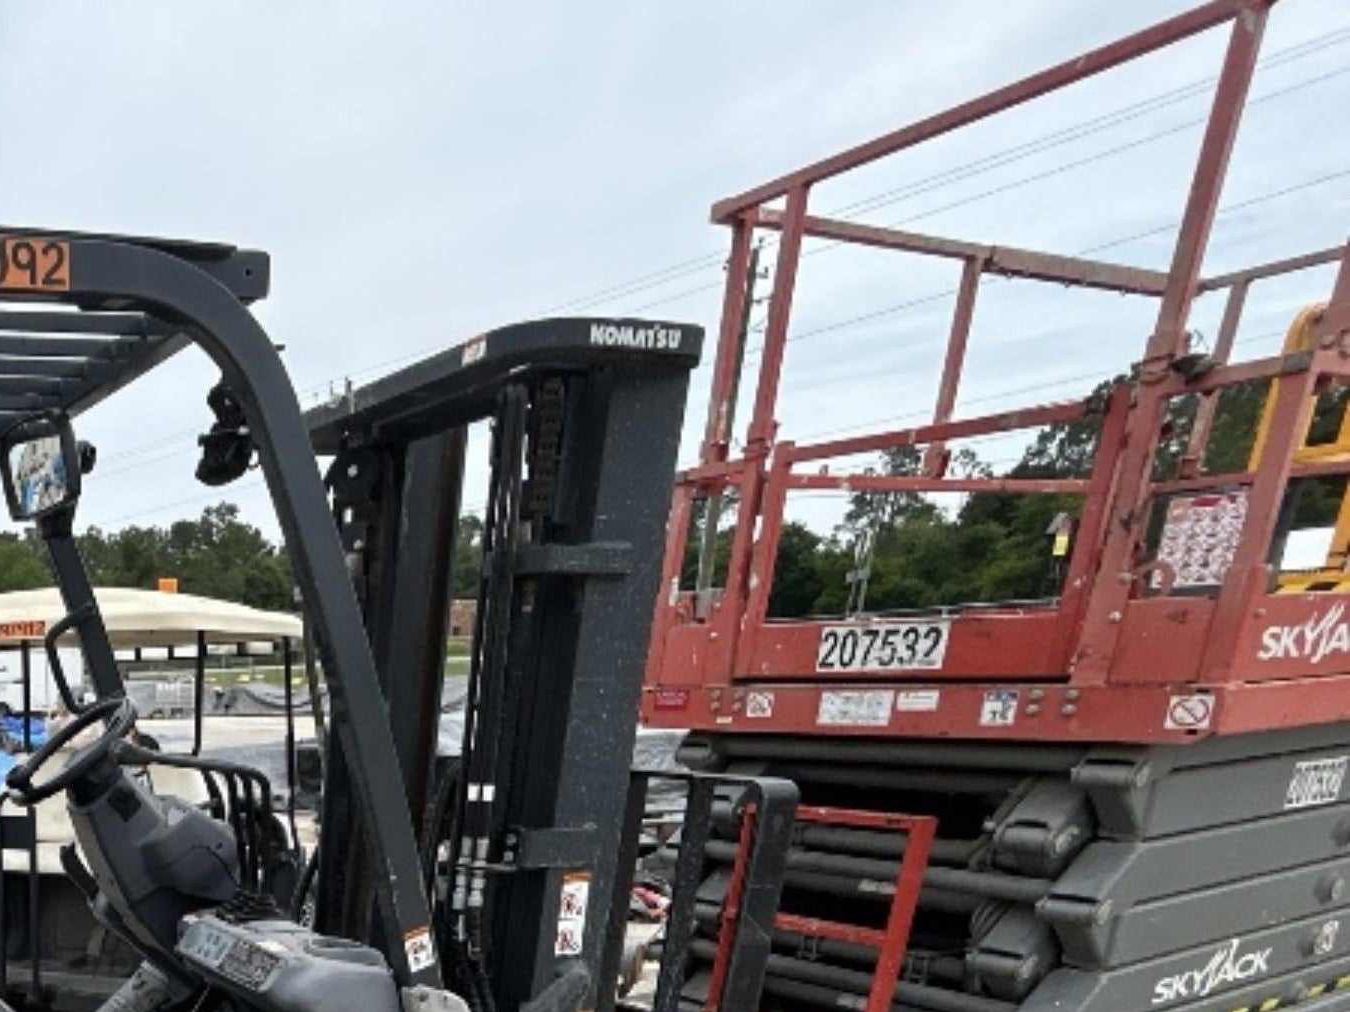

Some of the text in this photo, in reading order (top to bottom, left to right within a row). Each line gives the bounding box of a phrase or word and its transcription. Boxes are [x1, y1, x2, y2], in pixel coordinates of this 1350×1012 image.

[590, 323, 682, 348] KOMATSU
[818, 626, 943, 669] 207532
[1152, 938, 1273, 1003] SKYJACK
